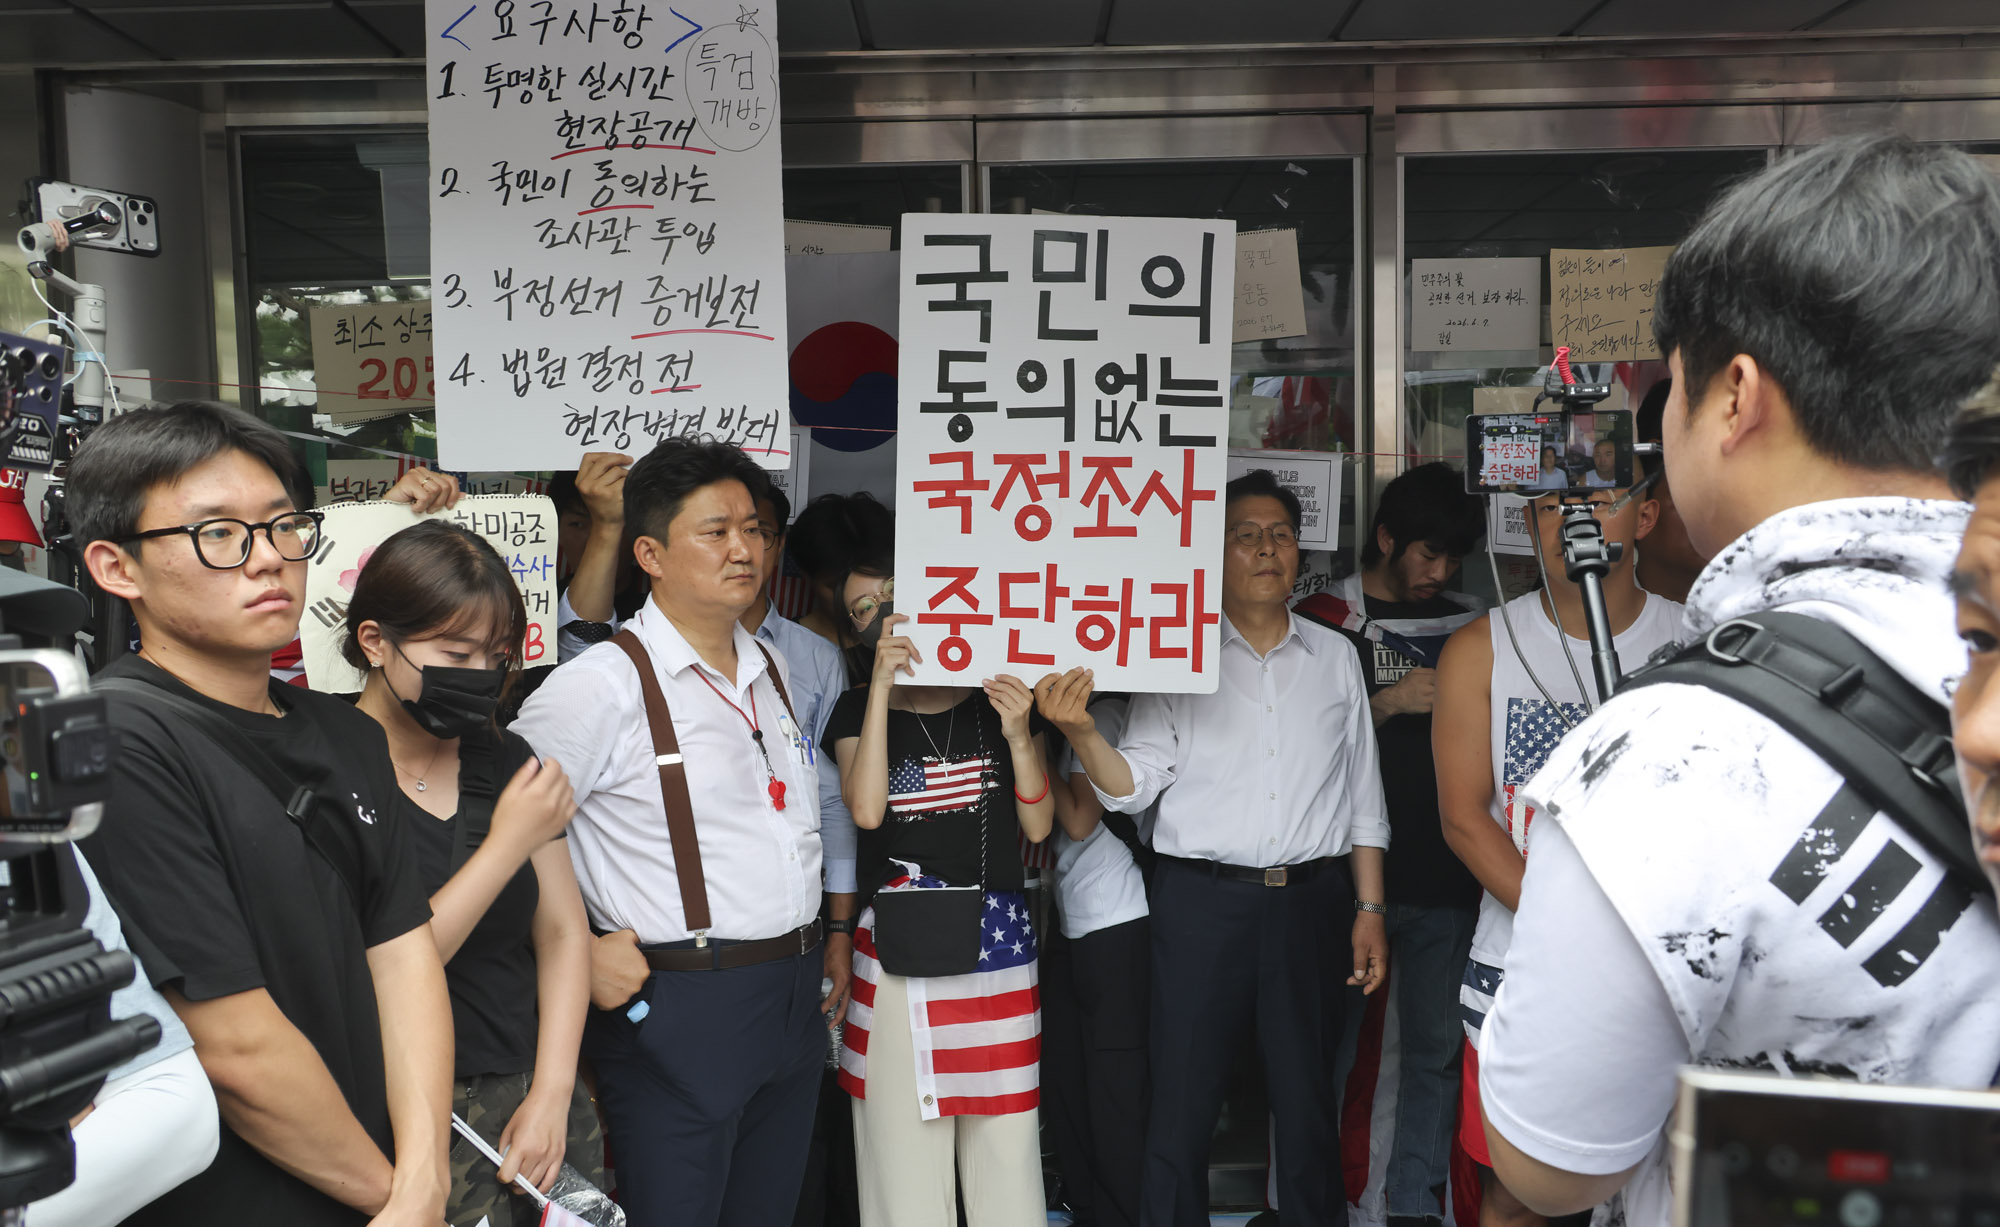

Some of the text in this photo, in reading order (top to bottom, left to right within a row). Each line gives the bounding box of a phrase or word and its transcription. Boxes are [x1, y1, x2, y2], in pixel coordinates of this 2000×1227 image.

[491, 0, 653, 49] 요구사항
[436, 61, 675, 109] 1. 투명한 실시간
[696, 43, 754, 92] 특검
[555, 109, 697, 151] 현장공개
[703, 97, 767, 131] 개방
[439, 159, 717, 208] 2. 국민이 동의하는
[534, 216, 718, 266] 조사관 투입
[442, 267, 761, 330] 3. 부정선거 증거보전
[915, 229, 1215, 344] 국민의
[334, 314, 386, 354] 최소
[448, 345, 695, 398] 4. 법원 결정 전
[1487, 442, 1539, 460] 국정조사
[1487, 463, 1540, 482] 중단하라
[912, 448, 1217, 548] 국정조사
[505, 553, 555, 583] 수사
[917, 563, 1220, 674] 중단하라
[1377, 668, 1412, 682] MATT
